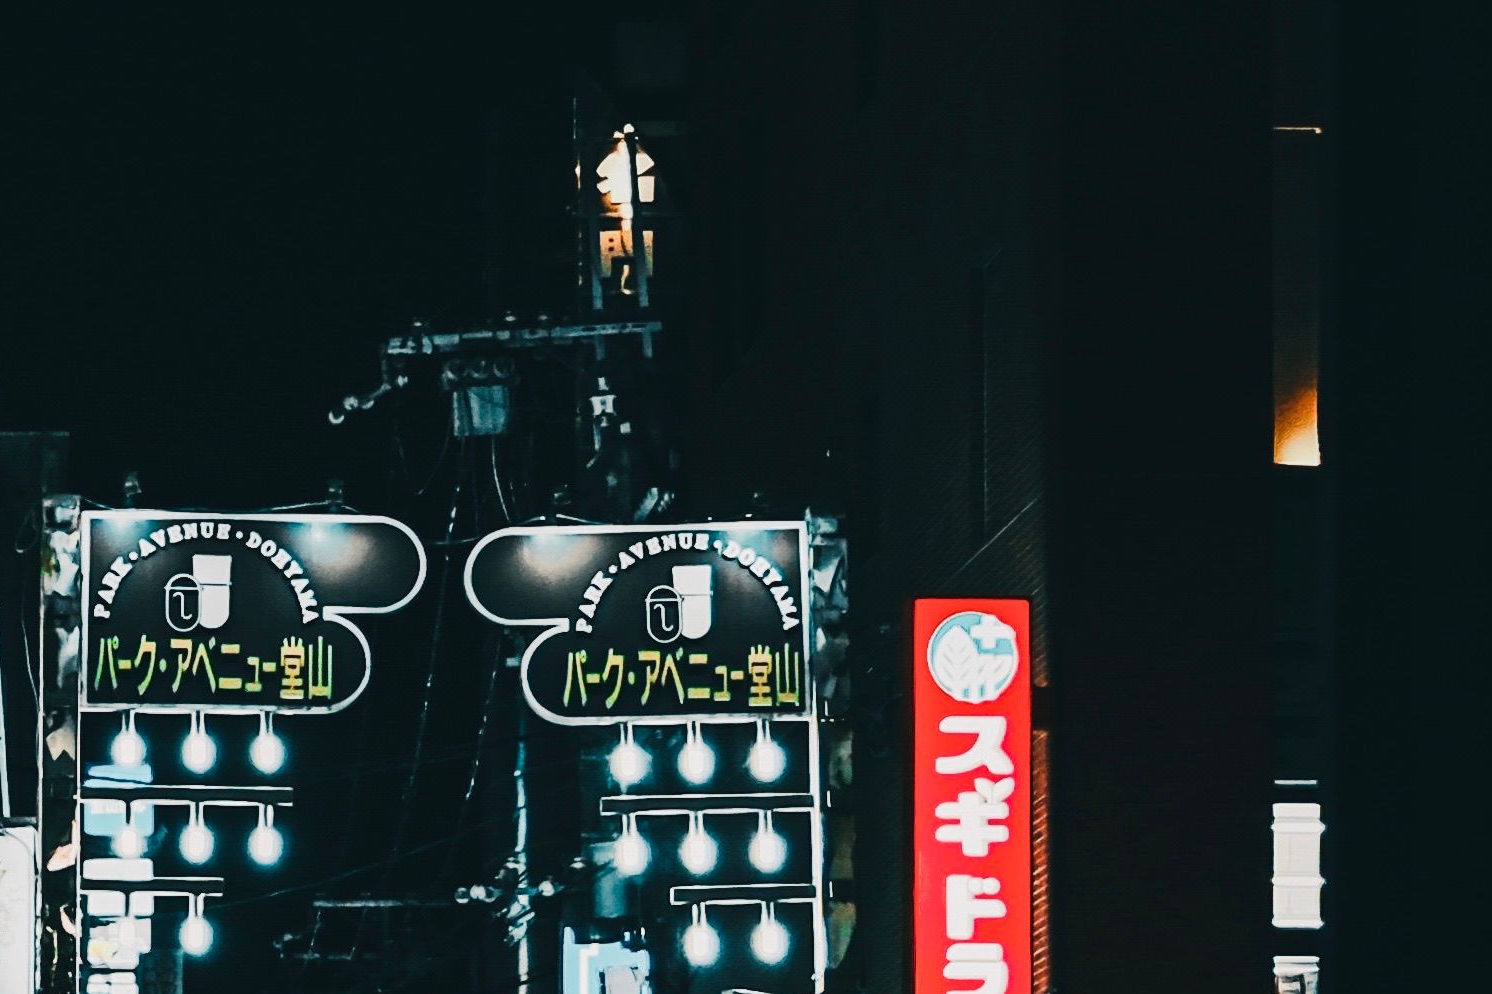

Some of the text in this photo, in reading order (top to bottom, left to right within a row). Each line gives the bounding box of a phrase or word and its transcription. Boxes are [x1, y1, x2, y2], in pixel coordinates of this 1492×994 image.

[94, 556, 135, 619] PARK
[138, 522, 231, 558] AVENUE
[575, 570, 613, 633] PARK
[618, 533, 709, 570] AVENUE
